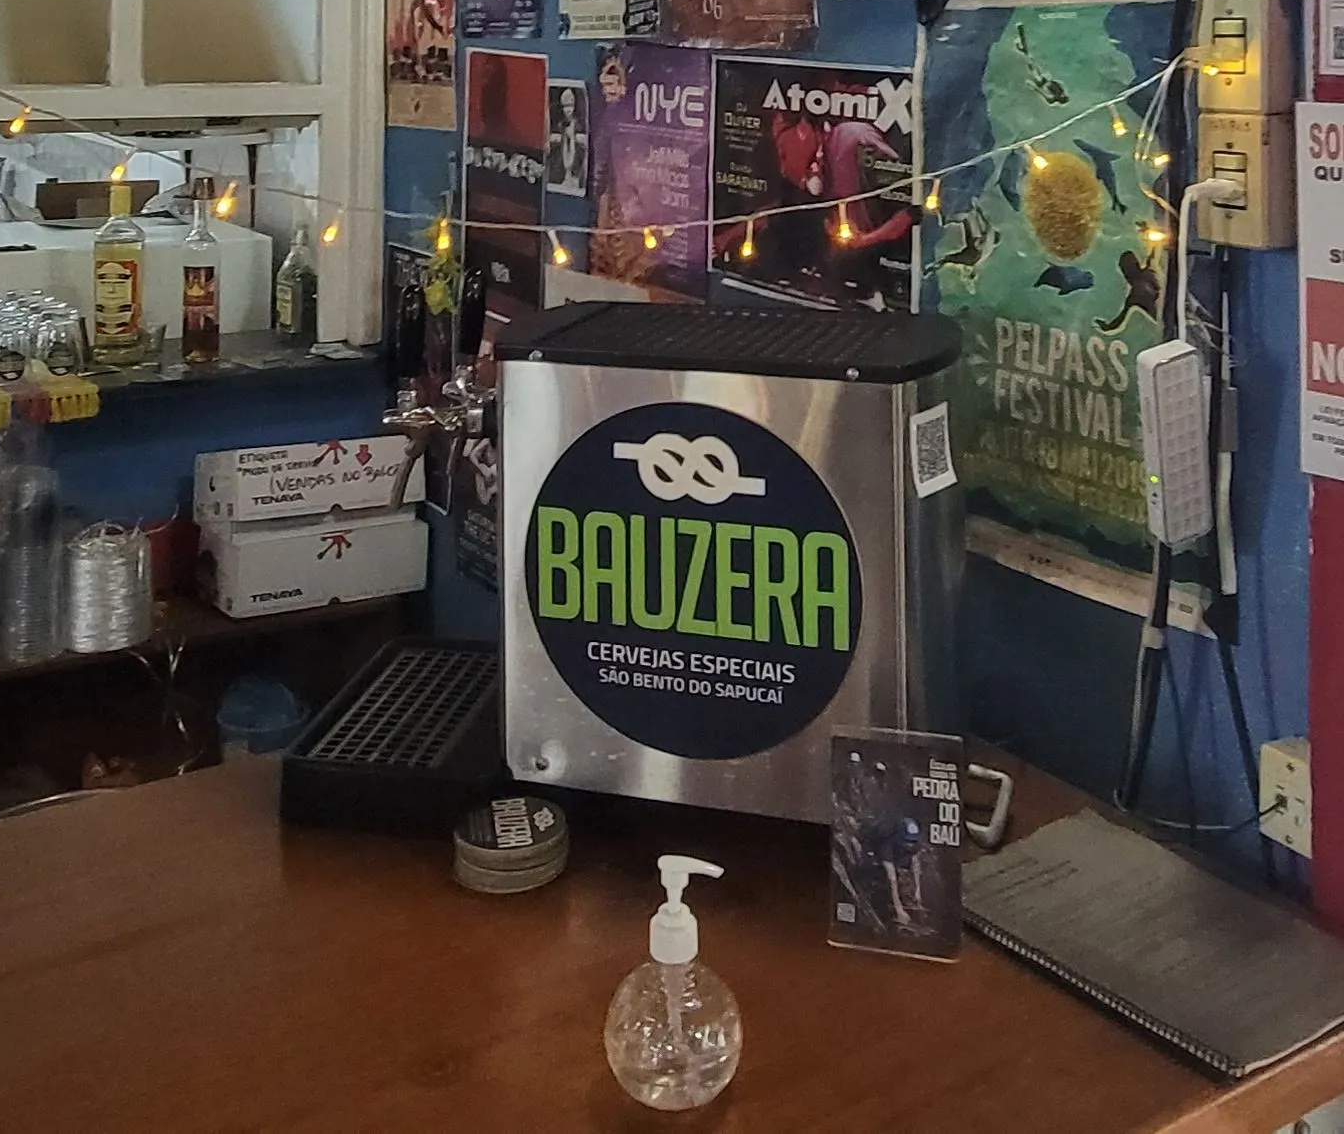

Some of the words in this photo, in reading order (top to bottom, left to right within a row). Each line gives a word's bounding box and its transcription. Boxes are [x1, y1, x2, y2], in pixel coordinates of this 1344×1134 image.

[635, 81, 705, 128] NYE
[762, 77, 914, 136] AtomiX
[994, 316, 1130, 393] PELPASS
[994, 368, 1132, 448] FESTIVAL
[252, 492, 305, 506] TENAYA
[250, 588, 304, 603] TENAYA
[537, 506, 851, 652] BAUZERA
[587, 640, 686, 671] CERVEJAS
[690, 652, 796, 684] ESPECIAIS
[598, 666, 630, 686] SÃO
[632, 671, 686, 694] BENTO
[688, 676, 712, 696] DO
[714, 680, 784, 705] SAPUCAÍ
[912, 776, 960, 801] PEDRA
[491, 798, 534, 849] BAUZERA
[938, 801, 960, 825] DO
